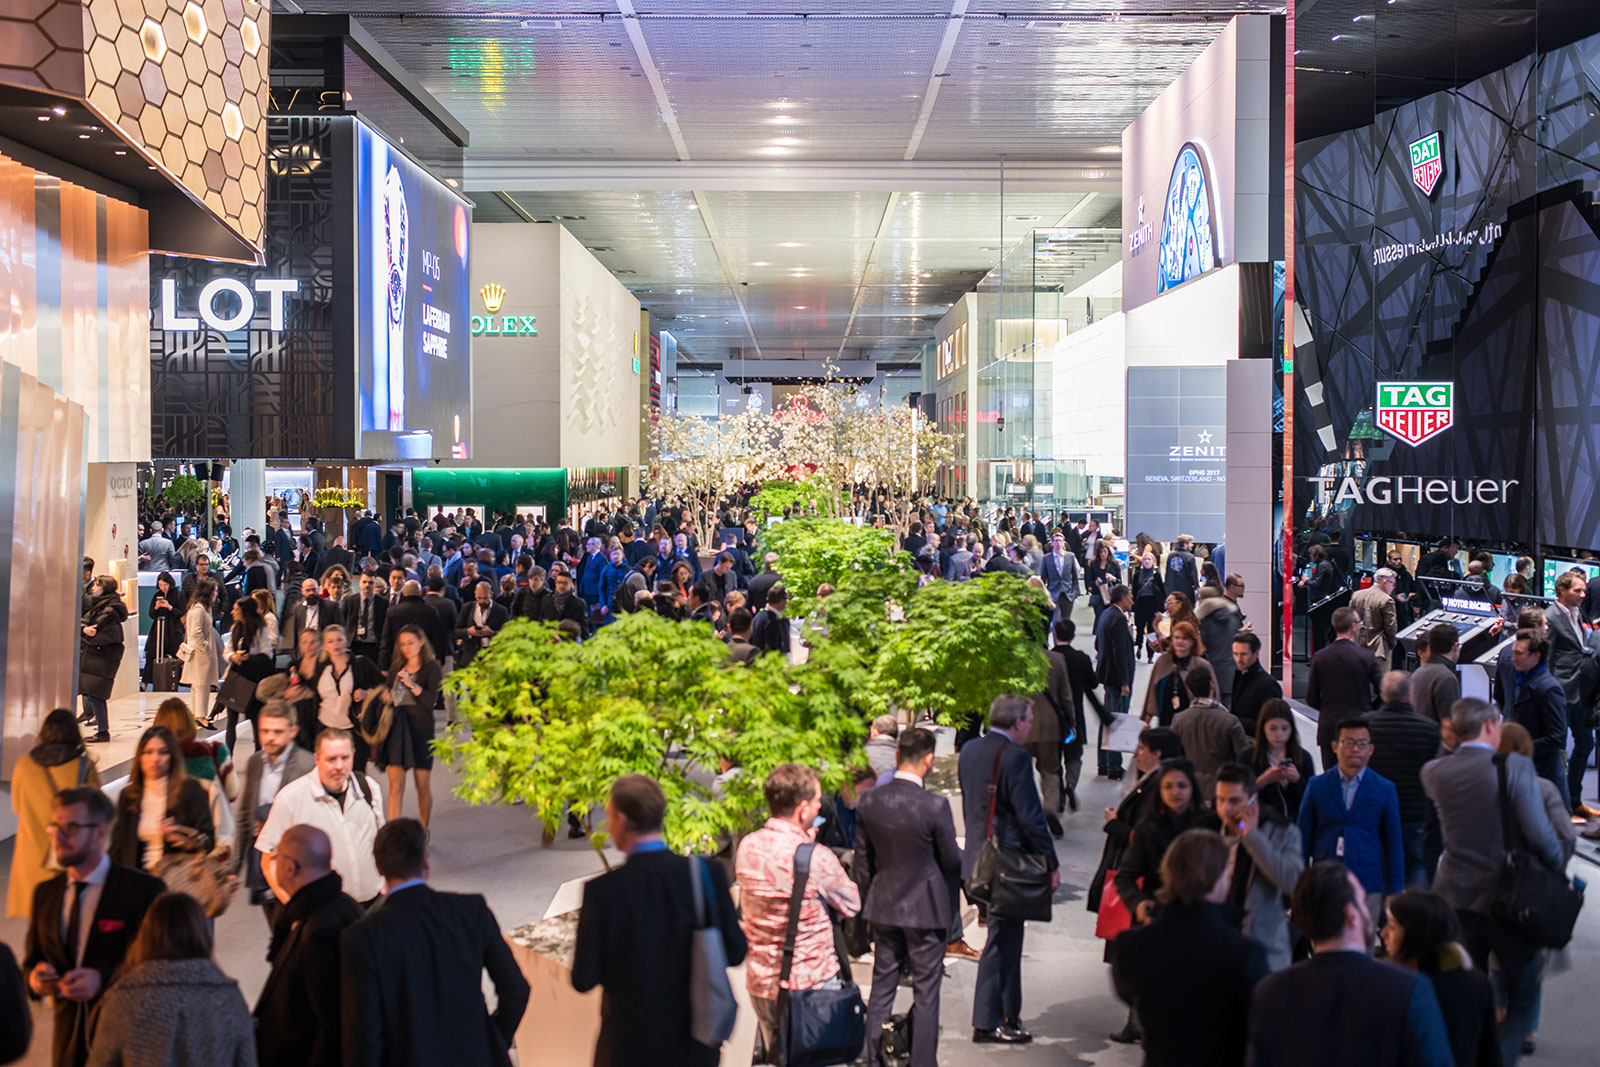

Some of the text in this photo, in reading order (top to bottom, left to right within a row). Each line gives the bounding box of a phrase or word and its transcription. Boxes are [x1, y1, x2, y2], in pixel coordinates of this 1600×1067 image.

[1129, 221, 1153, 253] ZENITH
[1383, 386, 1446, 406] TAG
[1381, 411, 1449, 441] HEUER
[110, 477, 133, 490] OCTO
